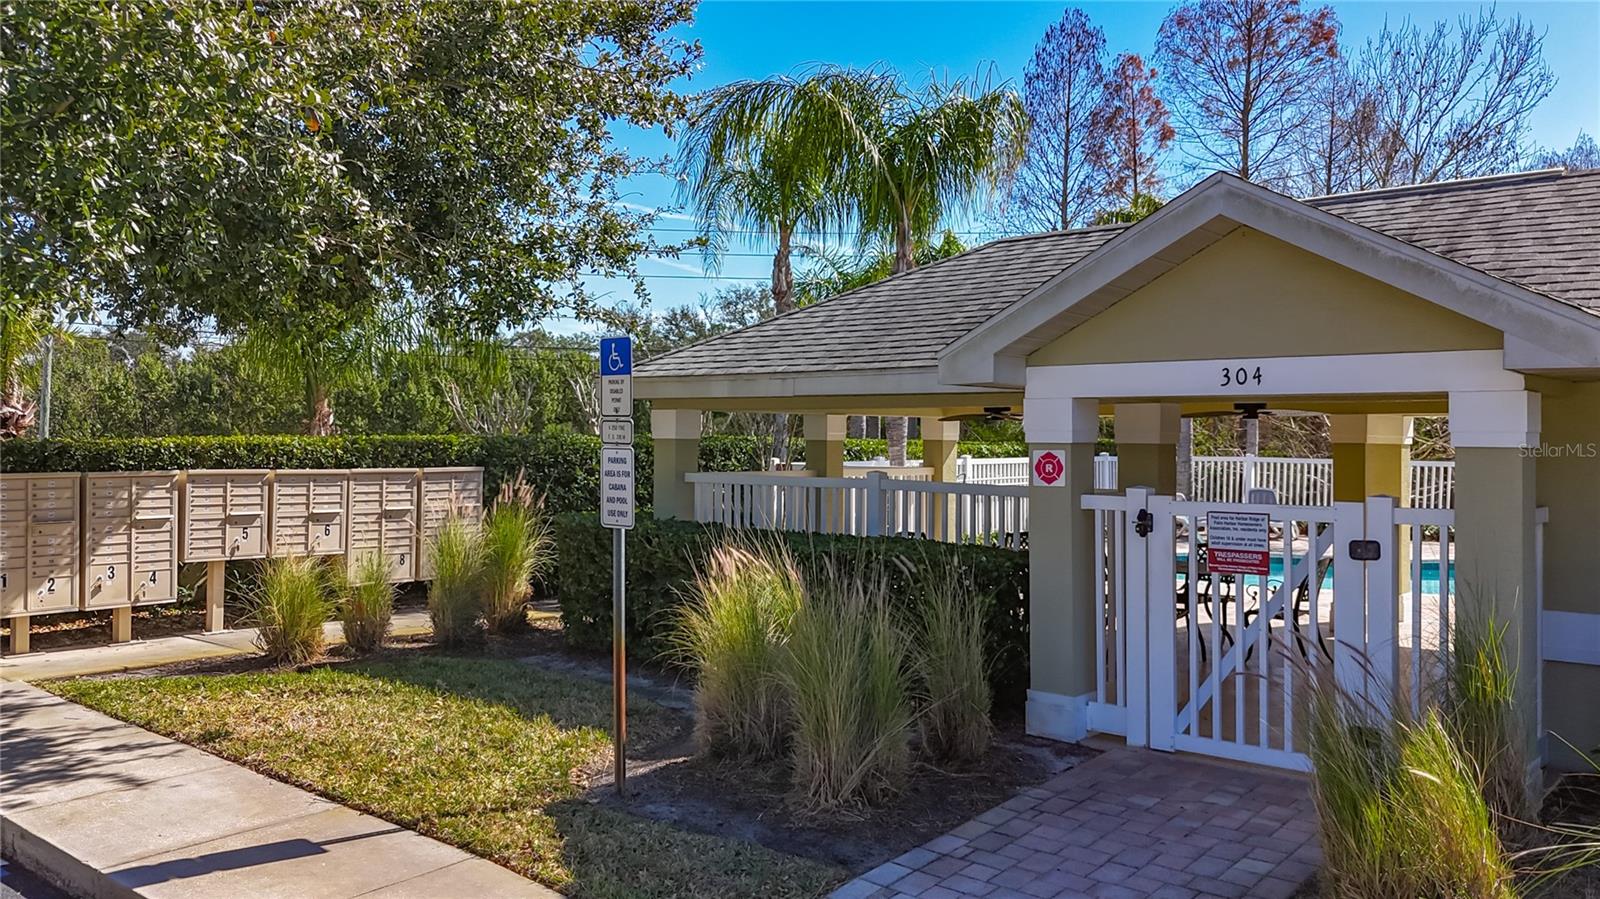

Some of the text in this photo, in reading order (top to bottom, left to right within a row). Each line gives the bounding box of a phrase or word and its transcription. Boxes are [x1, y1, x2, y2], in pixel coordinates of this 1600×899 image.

[1220, 366, 1262, 386] 304
[1046, 464, 1053, 472] R
[242, 528, 248, 540] 5
[324, 524, 330, 536] 6
[400, 553, 405, 565] 8
[1214, 551, 1262, 560] TRESPASSERS
[107, 566, 115, 580] 3
[149, 571, 157, 584] 4
[1, 573, 6, 588] 1
[47, 578, 55, 592] 2
